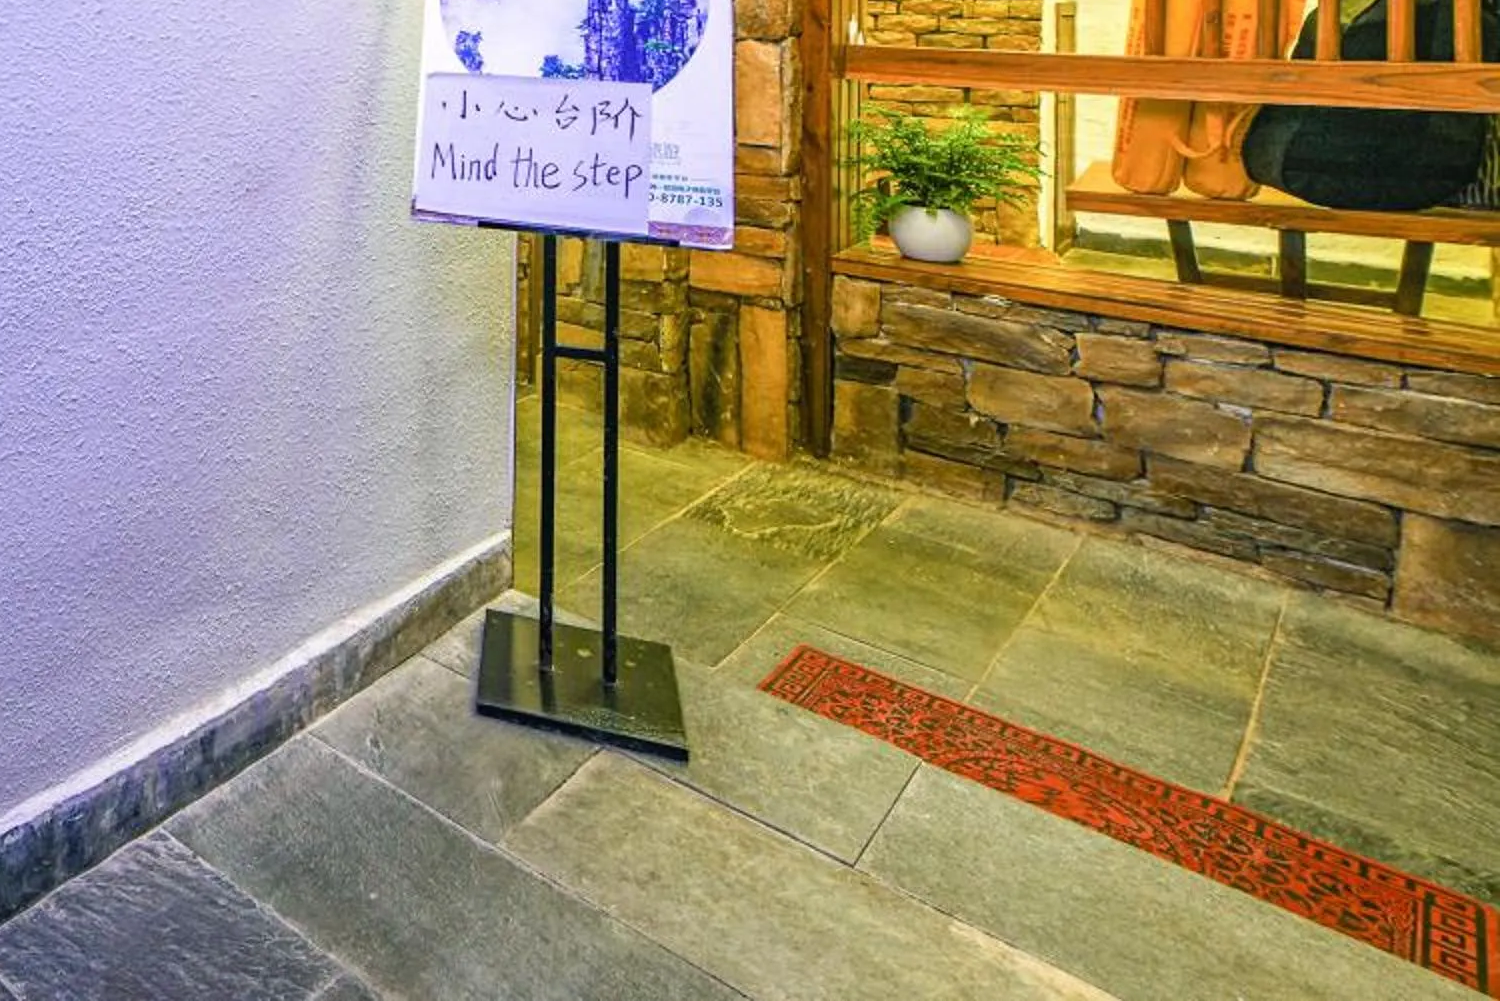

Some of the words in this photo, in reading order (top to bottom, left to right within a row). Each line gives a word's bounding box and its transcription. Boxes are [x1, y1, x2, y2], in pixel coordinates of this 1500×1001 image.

[441, 89, 644, 142] 小心台阶
[430, 142, 499, 182] Mind
[510, 146, 561, 190] the
[571, 152, 643, 199] step
